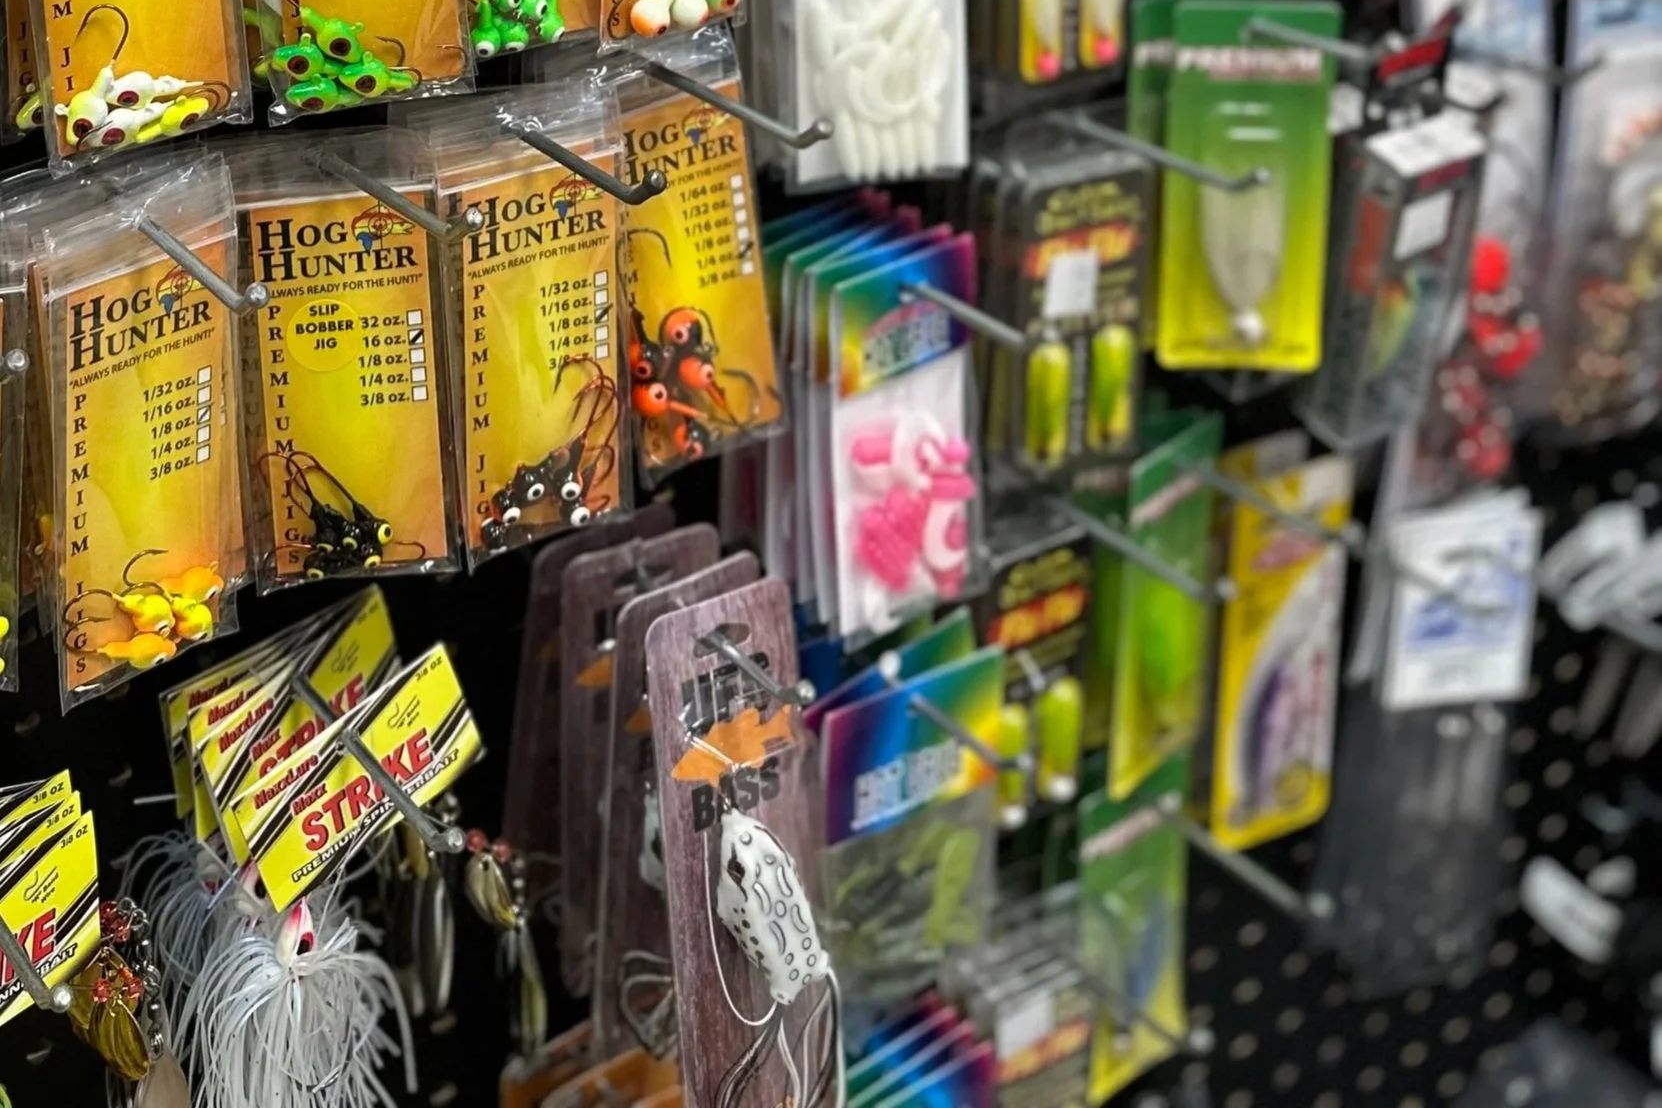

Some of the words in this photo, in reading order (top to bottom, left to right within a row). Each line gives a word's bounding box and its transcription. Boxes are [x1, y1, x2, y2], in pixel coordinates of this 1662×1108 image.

[256, 219, 348, 253] HOG
[468, 210, 606, 265] HUNTER
[258, 245, 418, 283] HUNTER
[540, 281, 570, 298] 1/32
[572, 279, 592, 291] oz.
[70, 287, 153, 340] HOG
[309, 303, 341, 317] SLIP
[69, 299, 213, 373] HUNTER
[295, 319, 355, 335] BOBBER
[314, 337, 338, 350] JIG
[111, 357, 142, 375] READY
[143, 348, 163, 364] FOR
[164, 341, 183, 358] THE
[143, 385, 174, 403] 1/32
[175, 377, 196, 391] oz.
[360, 391, 385, 406] 3/8
[388, 390, 411, 403] oz.
[143, 404, 174, 423] 1/16
[175, 397, 196, 411] oz.
[151, 423, 174, 441] 1/8
[175, 417, 195, 432] oz.
[49, 781, 65, 796] OZ
[61, 804, 76, 820] OZ
[75, 823, 89, 840] OZ
